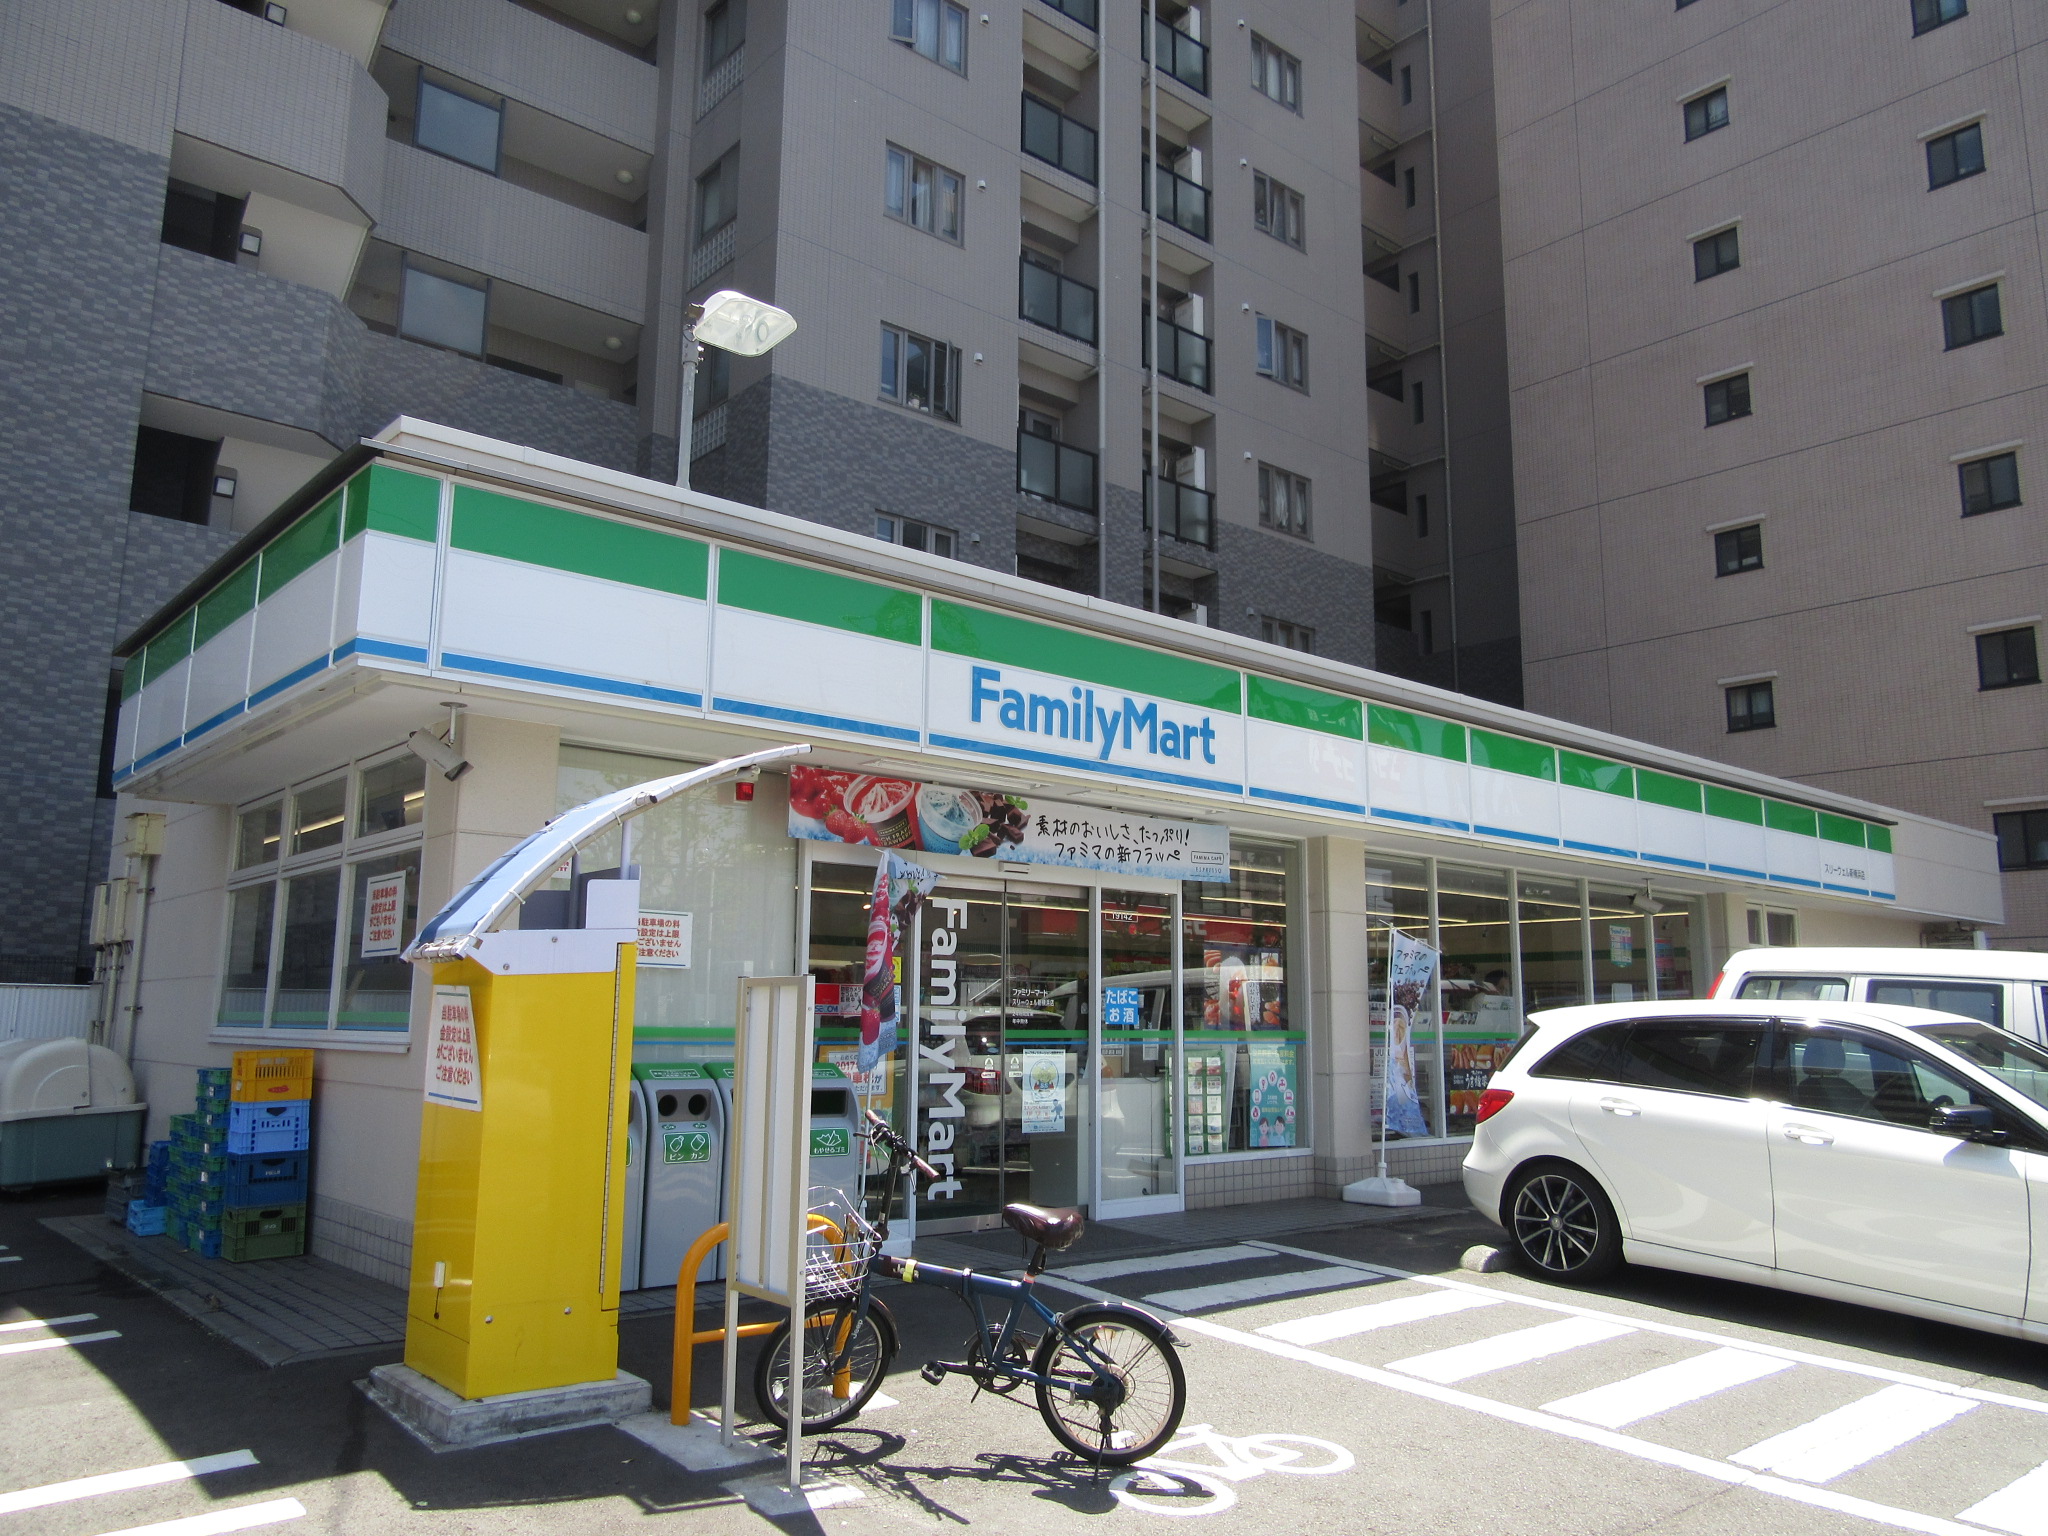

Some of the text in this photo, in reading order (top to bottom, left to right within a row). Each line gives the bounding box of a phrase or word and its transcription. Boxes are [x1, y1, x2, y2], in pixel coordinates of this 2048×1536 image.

[970, 665, 1216, 765] FamilyMart
[1054, 842, 1181, 864] ファミマの新フラッペ
[637, 938, 682, 947] ございません
[637, 948, 679, 957] 注意ください
[1396, 949, 1428, 961] ファミマの
[1012, 988, 1048, 997] ファミリーマート
[1106, 990, 1138, 1004] たばこ
[441, 1005, 469, 1022] 当駐車場の料
[1109, 1008, 1135, 1023] お酒
[439, 1025, 471, 1044] 金設定は上限
[436, 1044, 474, 1063] がございません
[920, 898, 968, 1201] FamilyMart
[836, 1061, 858, 1070] 2017
[435, 1065, 473, 1086] ご注意ください
[690, 1152, 705, 1160] カン
[814, 1146, 846, 1154] もやせるゴミ
[892, 1263, 919, 1279] Jep
[851, 1319, 864, 1339] Jeep
